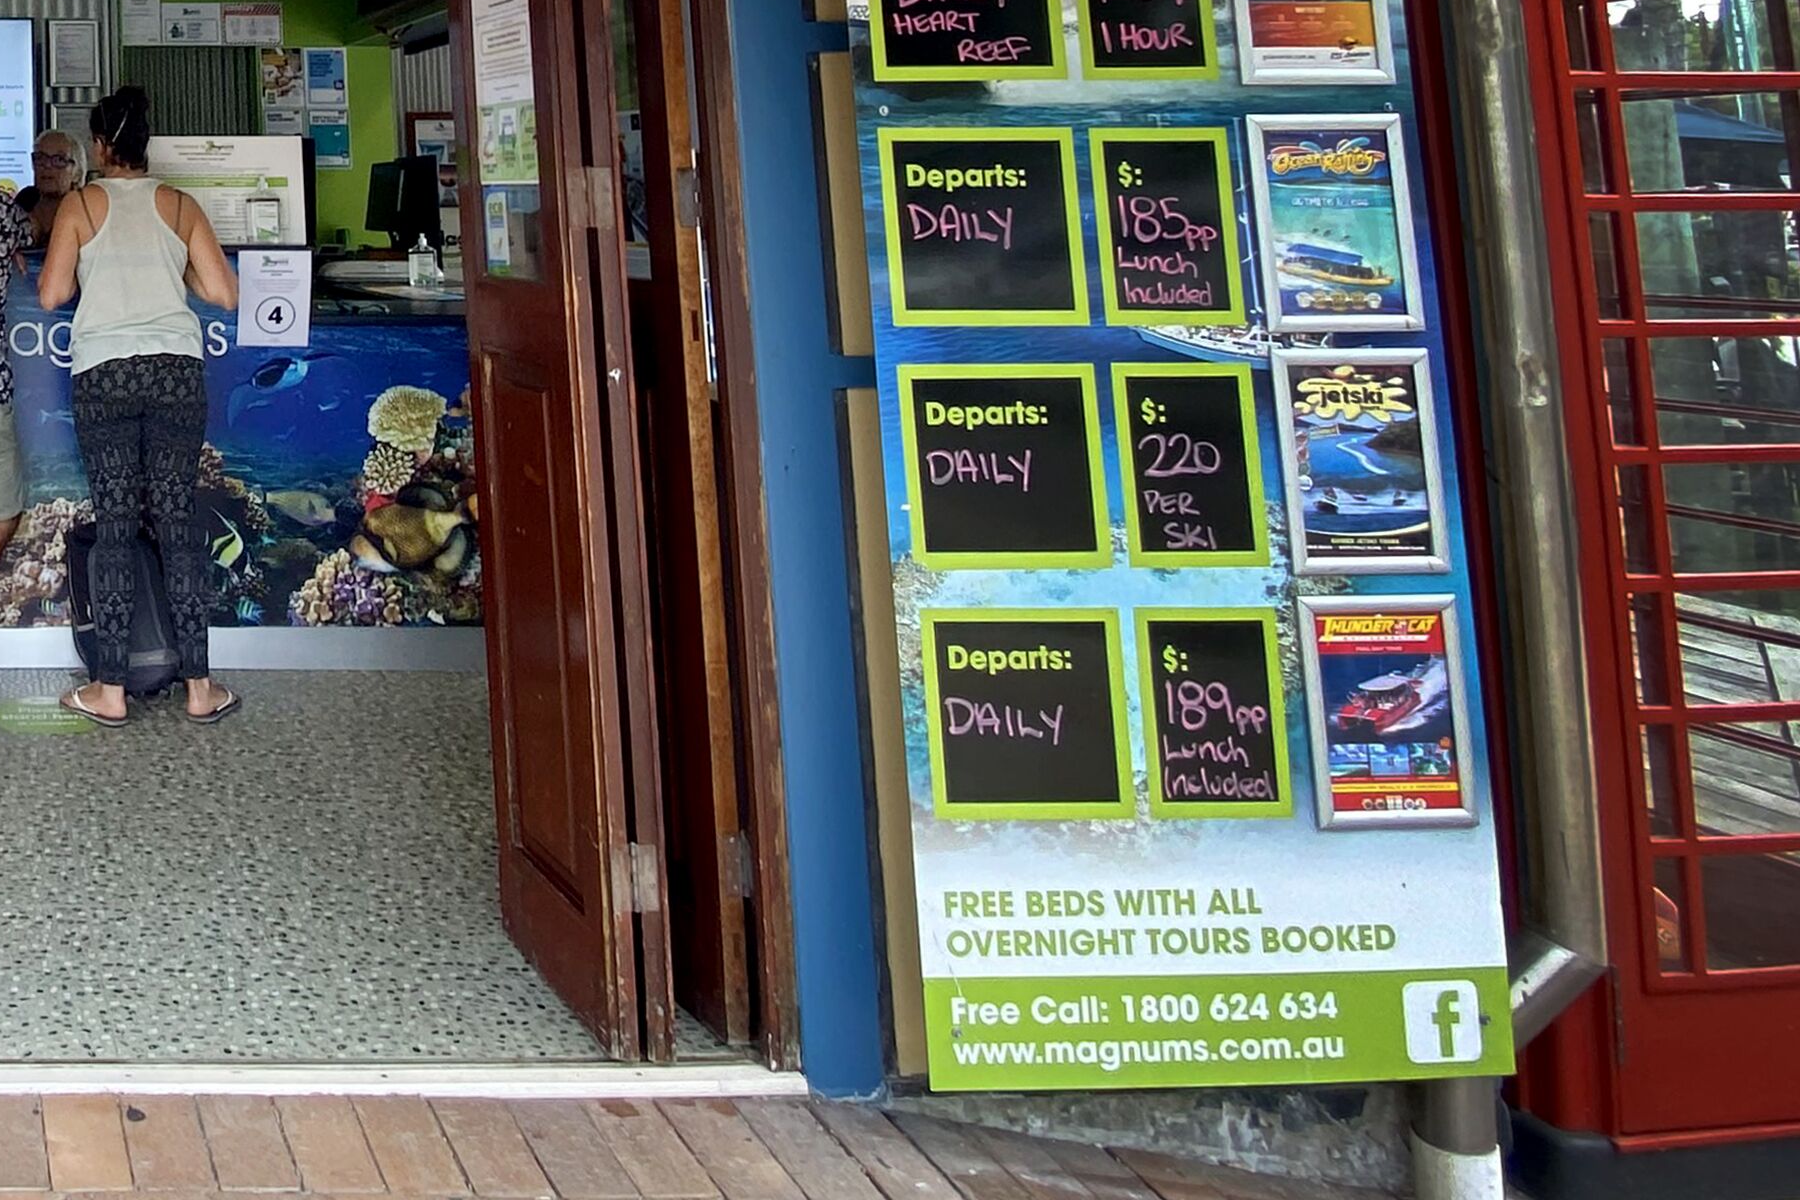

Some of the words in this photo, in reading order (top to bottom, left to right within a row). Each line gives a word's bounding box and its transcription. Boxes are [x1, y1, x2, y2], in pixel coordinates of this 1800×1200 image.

[893, 11, 981, 36] HEART
[1120, 23, 1194, 50] HOUR
[958, 36, 1032, 63] REEF
[906, 163, 1026, 192] Departs:
[906, 203, 1013, 250] DAILY
[1117, 195, 1218, 252] 185pp
[1117, 245, 1198, 278] Lunch
[1124, 278, 1213, 307] Included
[267, 305, 283, 324] 4
[1320, 387, 1384, 408] jetski
[925, 400, 1049, 429] Departs:
[926, 448, 1033, 492] DAILY
[1138, 433, 1222, 479] 220
[1145, 490, 1201, 517] PER
[1164, 521, 1218, 551] SKI
[1317, 615, 1395, 644] THUNDER
[1407, 616, 1438, 633] CAT
[947, 645, 1072, 675] Departs:
[944, 697, 1064, 745] DAILY
[1164, 680, 1267, 736] 189pp
[1164, 736, 1250, 767] Lunch
[1164, 767, 1275, 800] Included
[943, 890, 1015, 918] FREE
[1026, 889, 1106, 918] BEDS
[1113, 888, 1196, 917] WITH
[1208, 888, 1262, 916] ALL
[946, 927, 1146, 958] OVERNIGHT
[1151, 926, 1251, 956] TOURS
[1261, 923, 1397, 953] BOOKED
[952, 995, 1020, 1026] Free
[1033, 994, 1109, 1024] Call:
[1121, 993, 1199, 1023] 1800
[1208, 992, 1270, 1022] 624
[1279, 991, 1338, 1019] 634
[953, 1034, 1345, 1071] www.magnums.com.au
